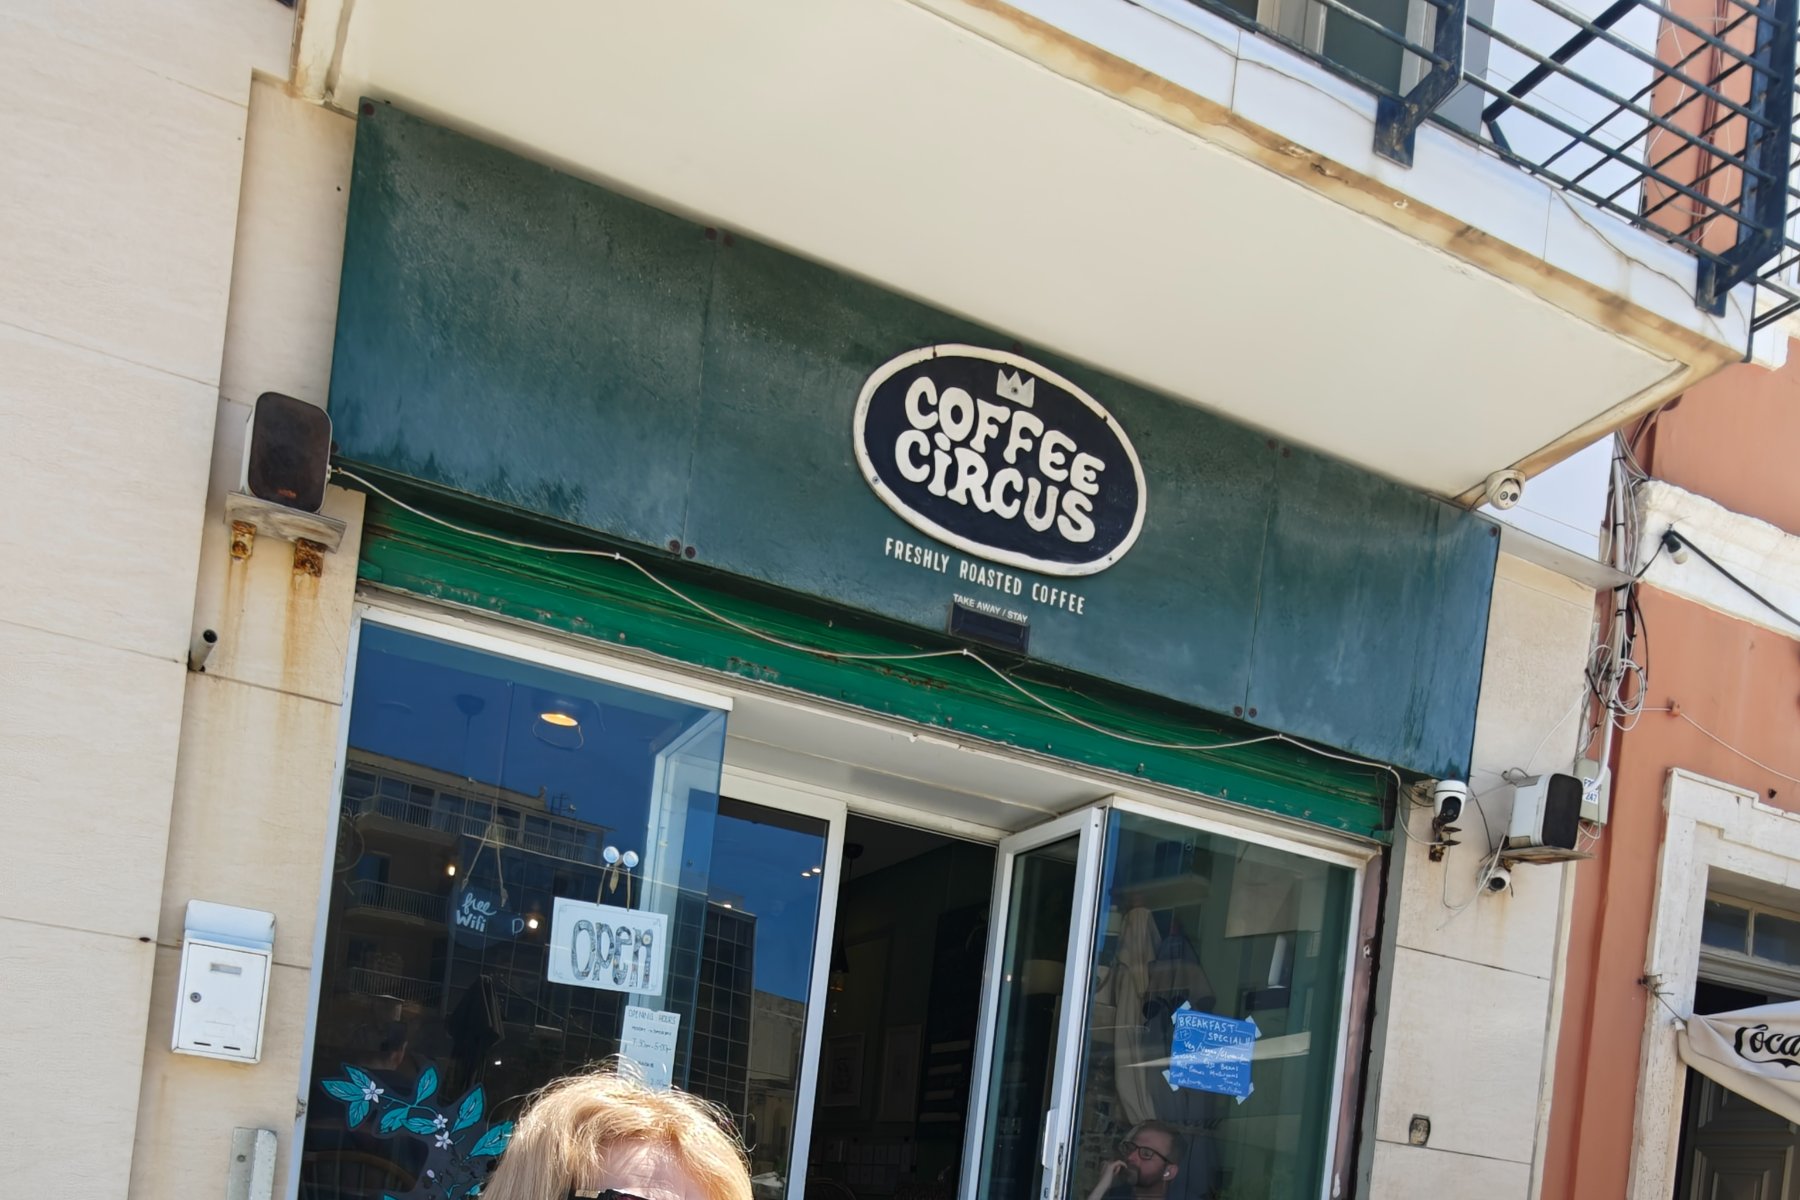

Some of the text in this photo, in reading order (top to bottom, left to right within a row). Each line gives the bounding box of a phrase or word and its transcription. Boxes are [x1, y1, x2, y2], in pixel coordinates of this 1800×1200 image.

[904, 376, 1106, 495] COFFEE
[885, 537, 1086, 615] FRESHLY ROASTED COFFEE
[953, 594, 975, 608] TAKE
[976, 602, 1001, 616] AWAY
[1007, 610, 1028, 624] STAY
[1178, 1016, 1235, 1033] BREAKFAST
